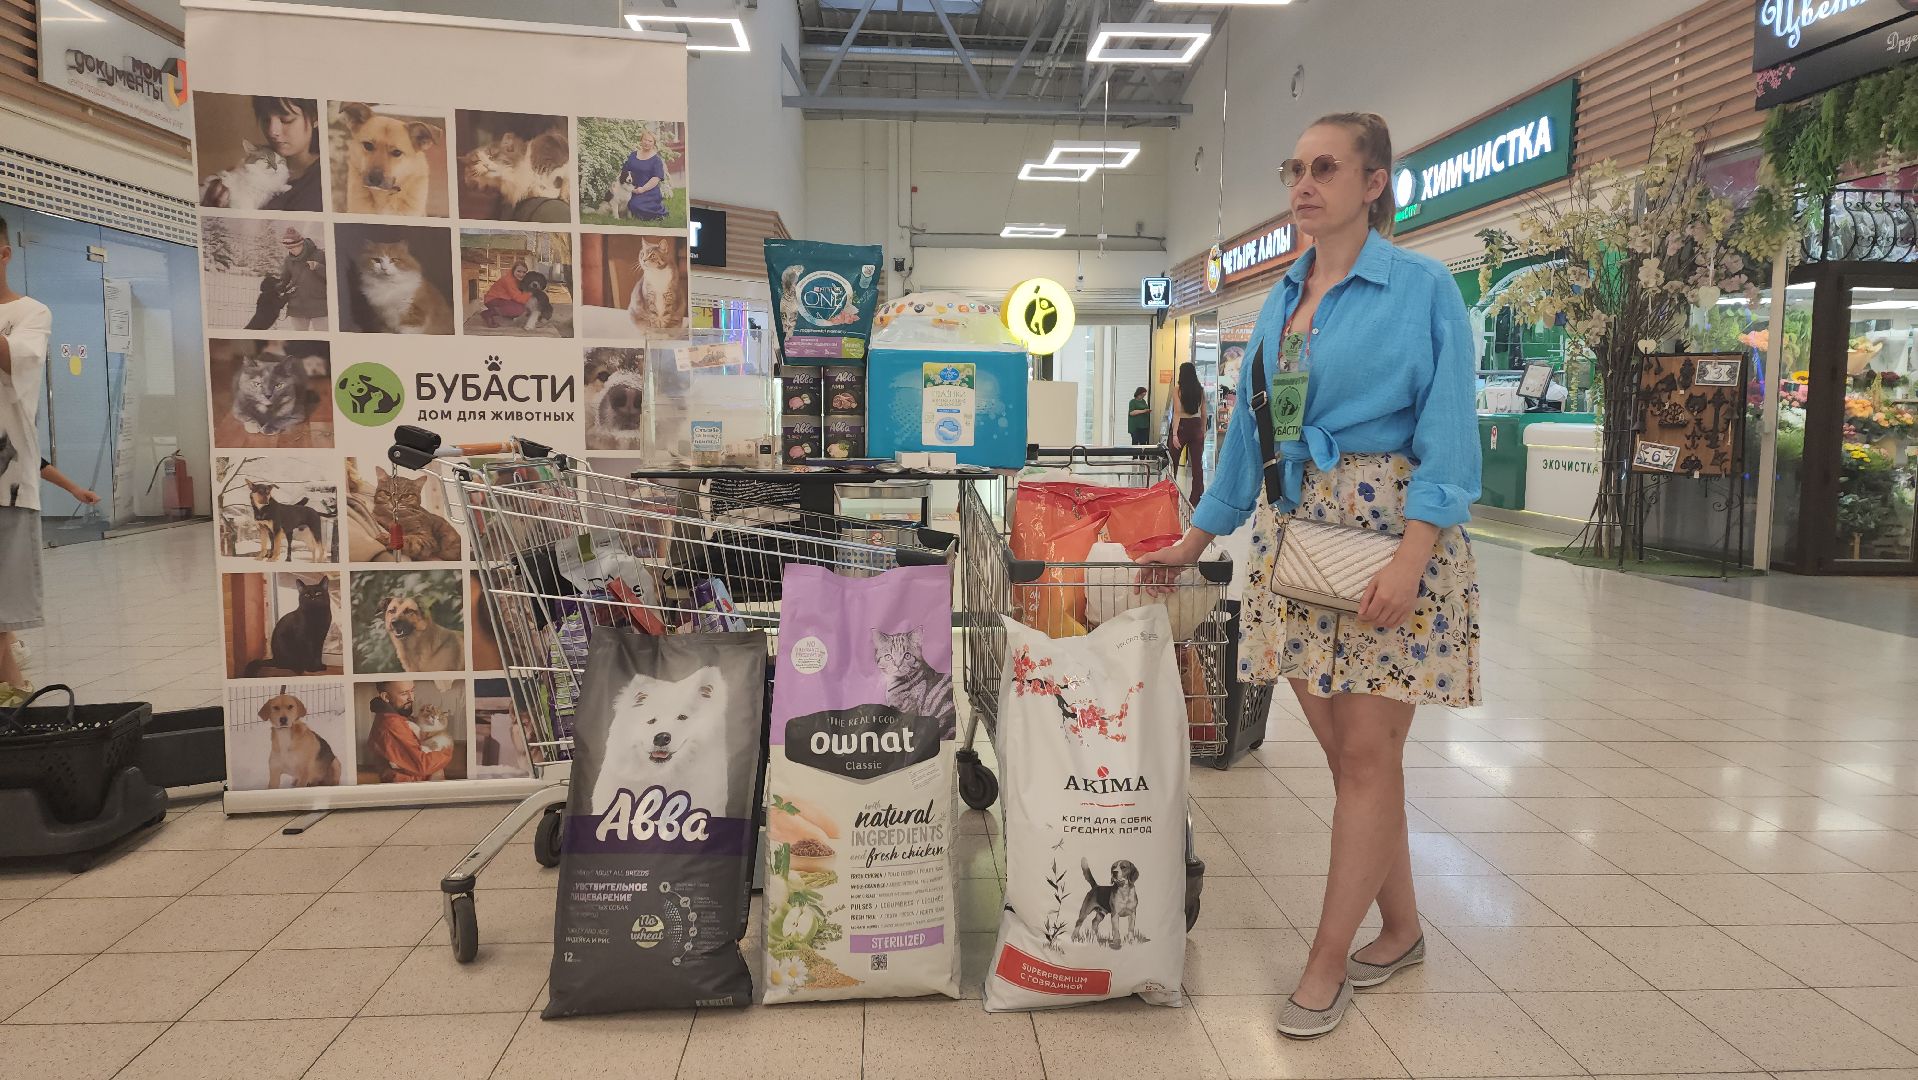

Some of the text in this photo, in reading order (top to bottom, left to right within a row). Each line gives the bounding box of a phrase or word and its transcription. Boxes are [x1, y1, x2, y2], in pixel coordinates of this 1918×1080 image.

[1760, 0, 1869, 48] Цвет
[1420, 115, 1552, 201] ХИМЧИСТКА
[1223, 223, 1291, 275] ЧЕТЫРЕ ЛАПЫ
[416, 373, 575, 403] БУБАСТИ
[418, 410, 575, 422] ДОМ ДЛЯ ЖИВОТНЫХ
[1651, 450, 1661, 463] 6
[830, 716, 845, 727] THE
[849, 716, 870, 726] REAL
[810, 727, 915, 755] ownat
[845, 761, 882, 770] Classic
[1064, 774, 1149, 794] AKIMA
[854, 798, 936, 828] natural
[1062, 815, 1091, 823] КОРМ
[1120, 816, 1153, 824] СОБАК
[851, 824, 944, 846] INGREDIENTS
[1063, 826, 1152, 834] СРЕДНИХ ПОРОД
[866, 847, 900, 868] fresh
[902, 843, 945, 860] chicken
[573, 882, 648, 892] УВСТВИТЕЛЬНОЕ
[639, 915, 656, 926] No
[630, 927, 664, 940] wheat
[871, 933, 926, 949] STERILIZED
[563, 951, 574, 962] 12
[1020, 972, 1084, 991] С ГОВЯДИНОЙ
[1022, 962, 1088, 984] SUPERPREMIUM
